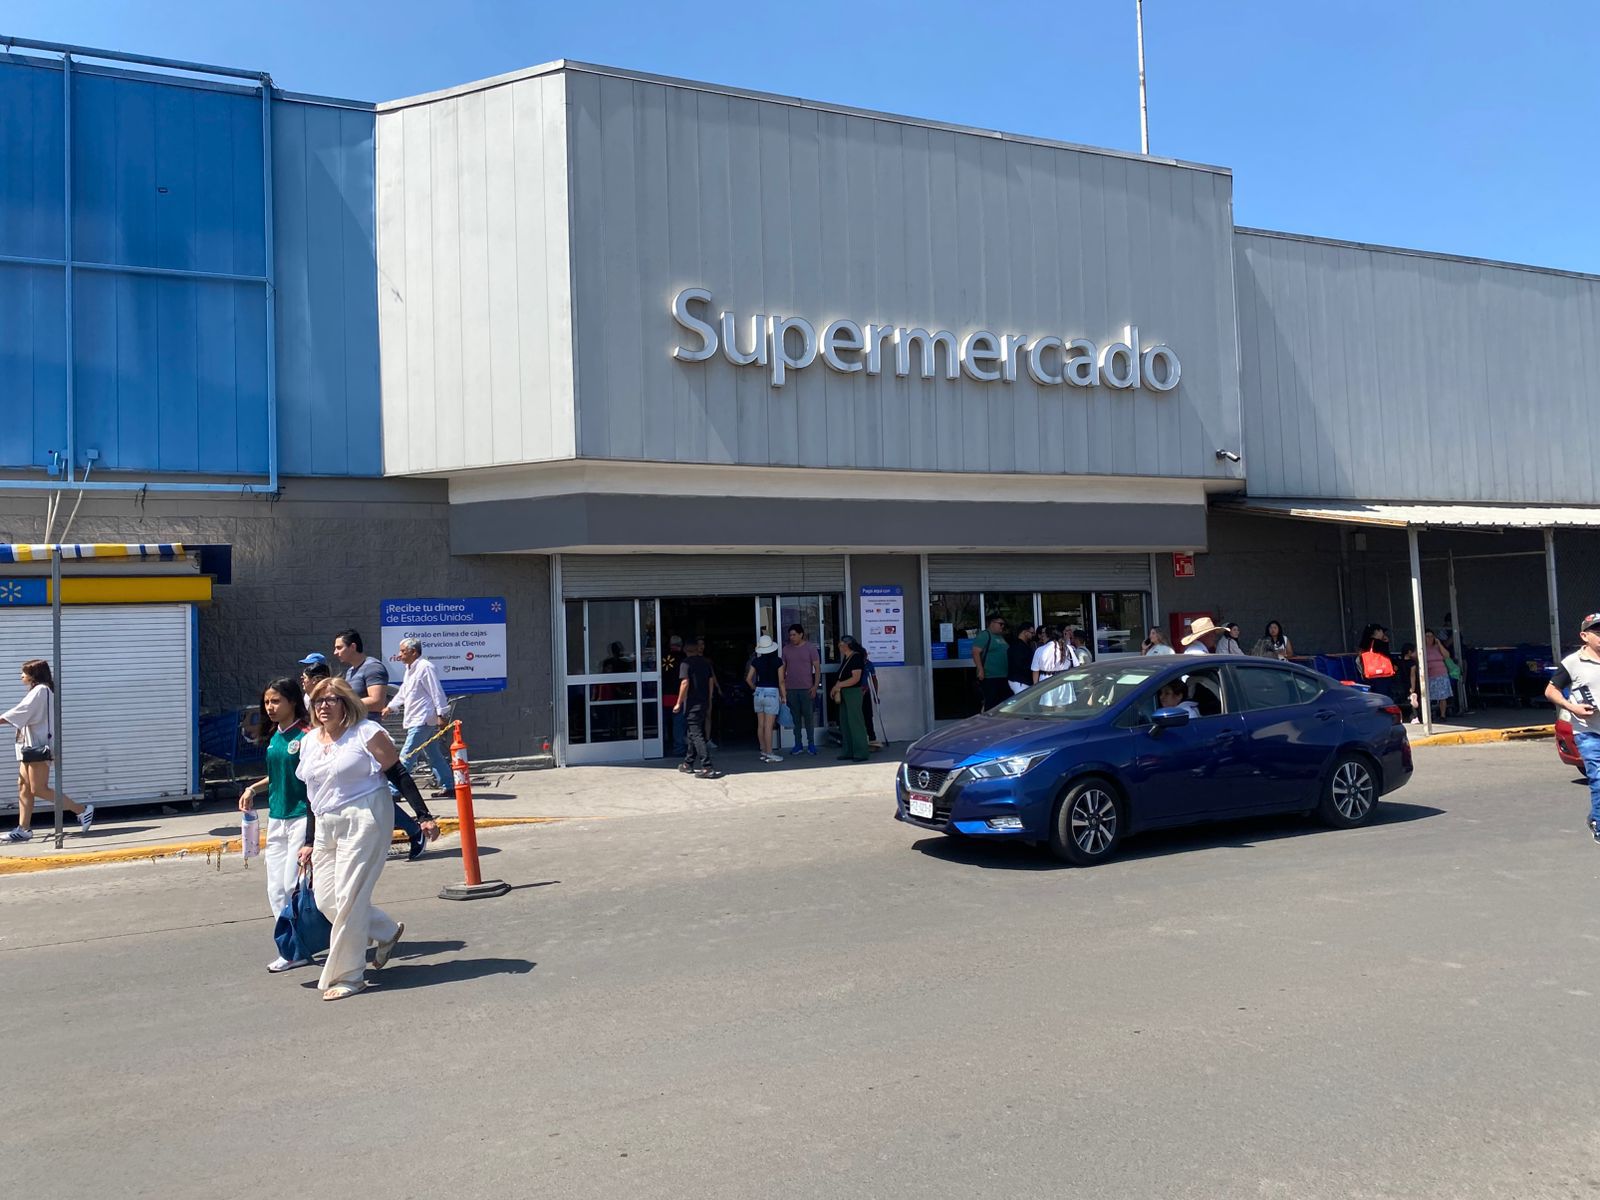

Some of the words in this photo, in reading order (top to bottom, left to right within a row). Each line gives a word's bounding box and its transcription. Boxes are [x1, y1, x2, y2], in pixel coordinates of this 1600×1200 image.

[671, 287, 1182, 393] Supermercado
[386, 603, 421, 614] ¡Recibe
[423, 604, 433, 612] tu
[434, 603, 465, 612] dinero
[386, 615, 399, 623] de
[400, 614, 438, 623] Estados
[439, 613, 474, 622] Unidos!
[469, 630, 488, 638] cajas
[422, 641, 453, 649] Servicios
